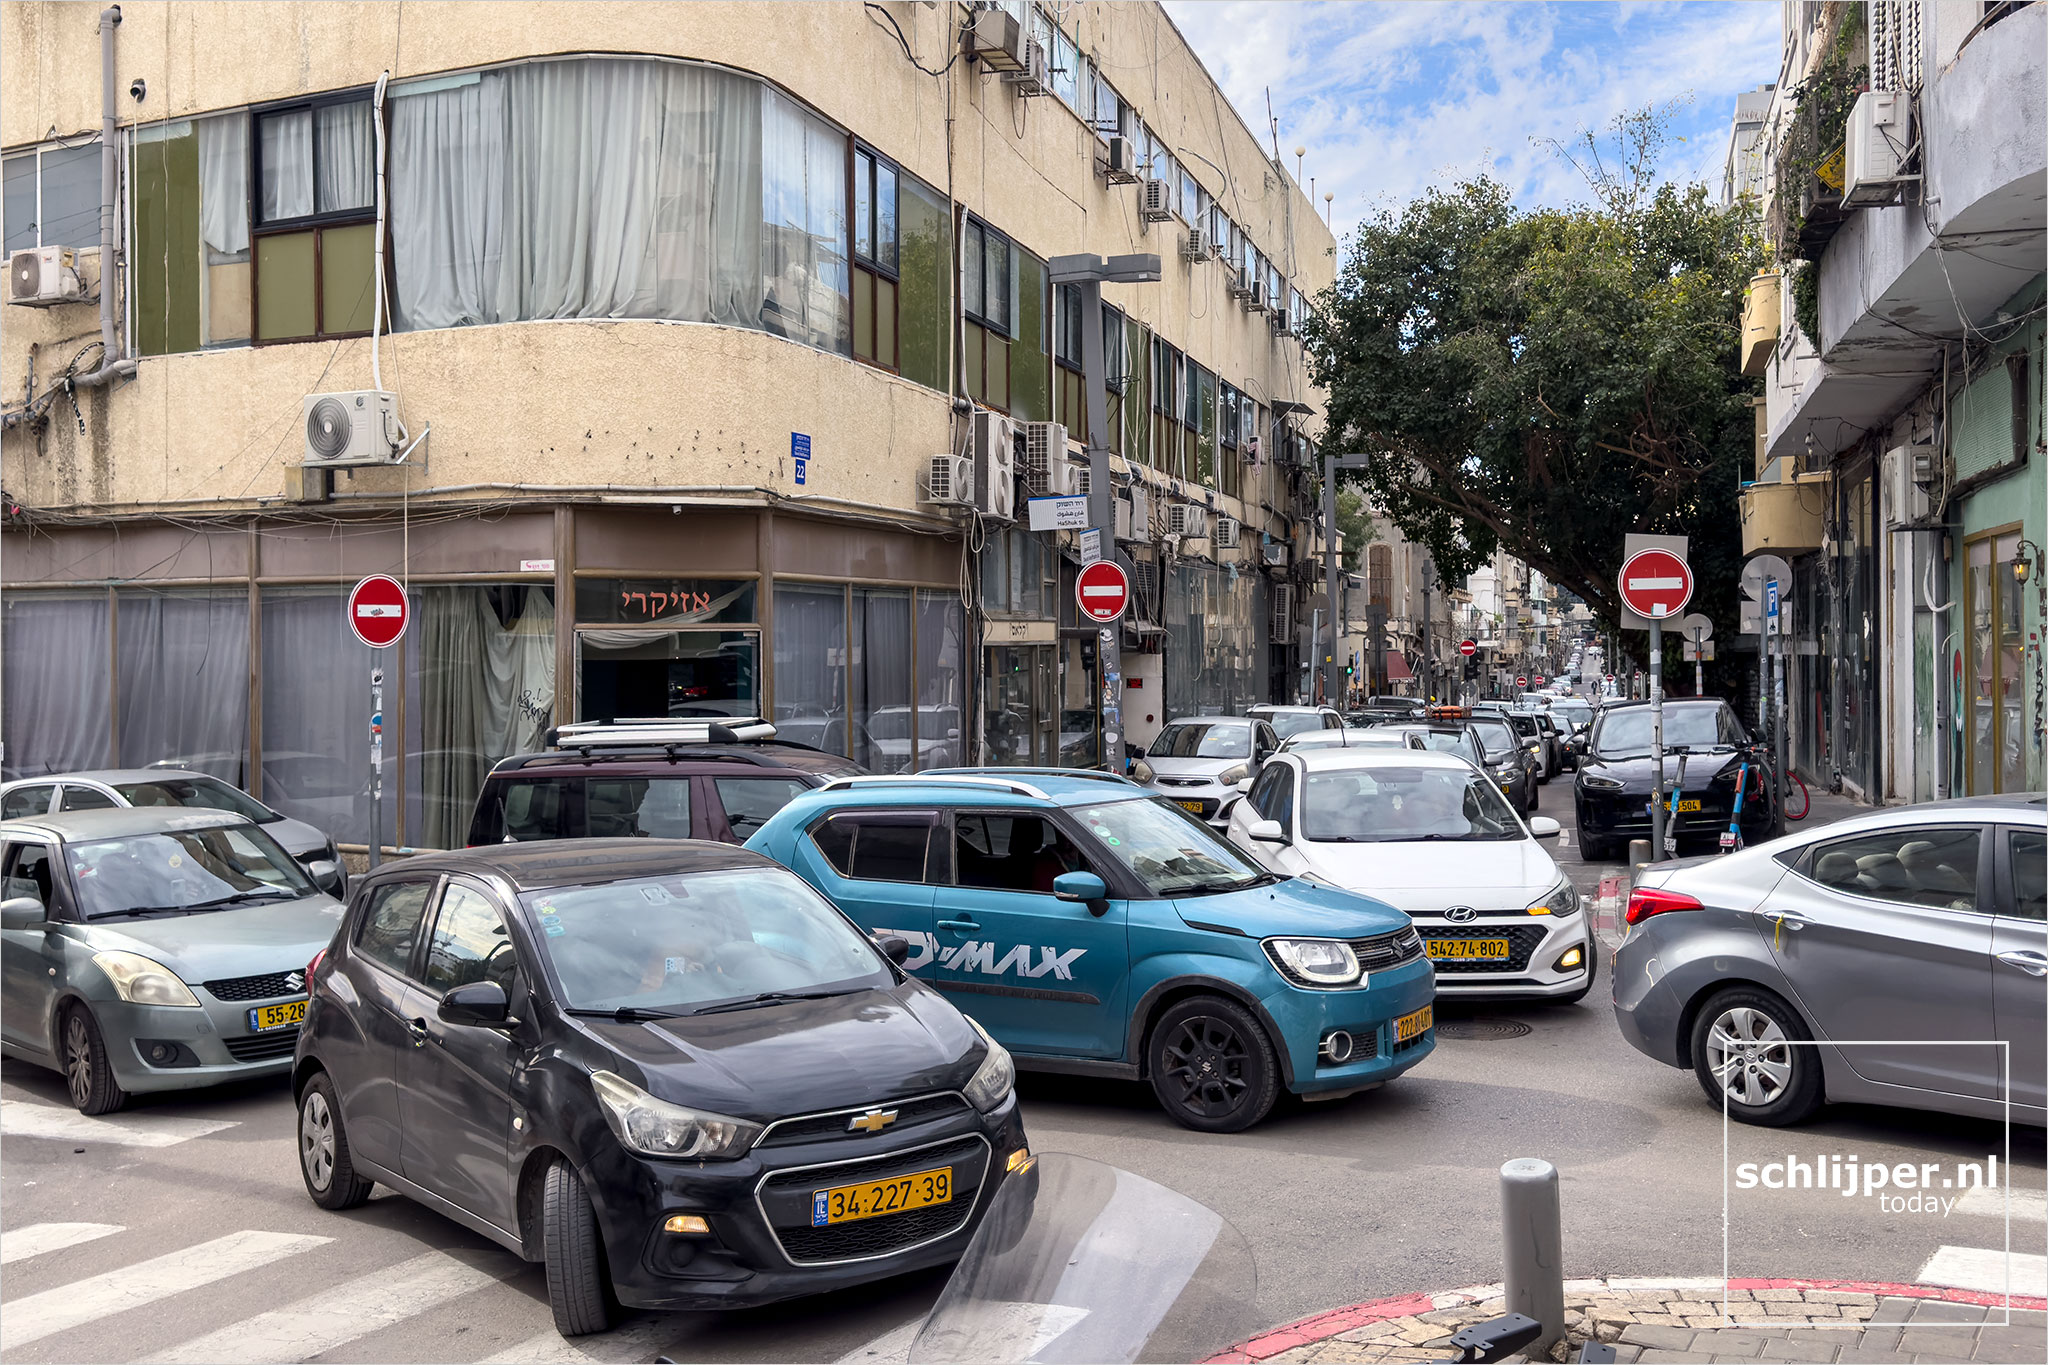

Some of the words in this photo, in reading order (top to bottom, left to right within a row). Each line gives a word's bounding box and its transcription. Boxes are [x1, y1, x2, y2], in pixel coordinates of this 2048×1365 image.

[796, 464, 805, 479] 22
[1056, 500, 1074, 509] השוק
[1057, 519, 1078, 527] HaShuk
[622, 591, 711, 619] אזיקרי
